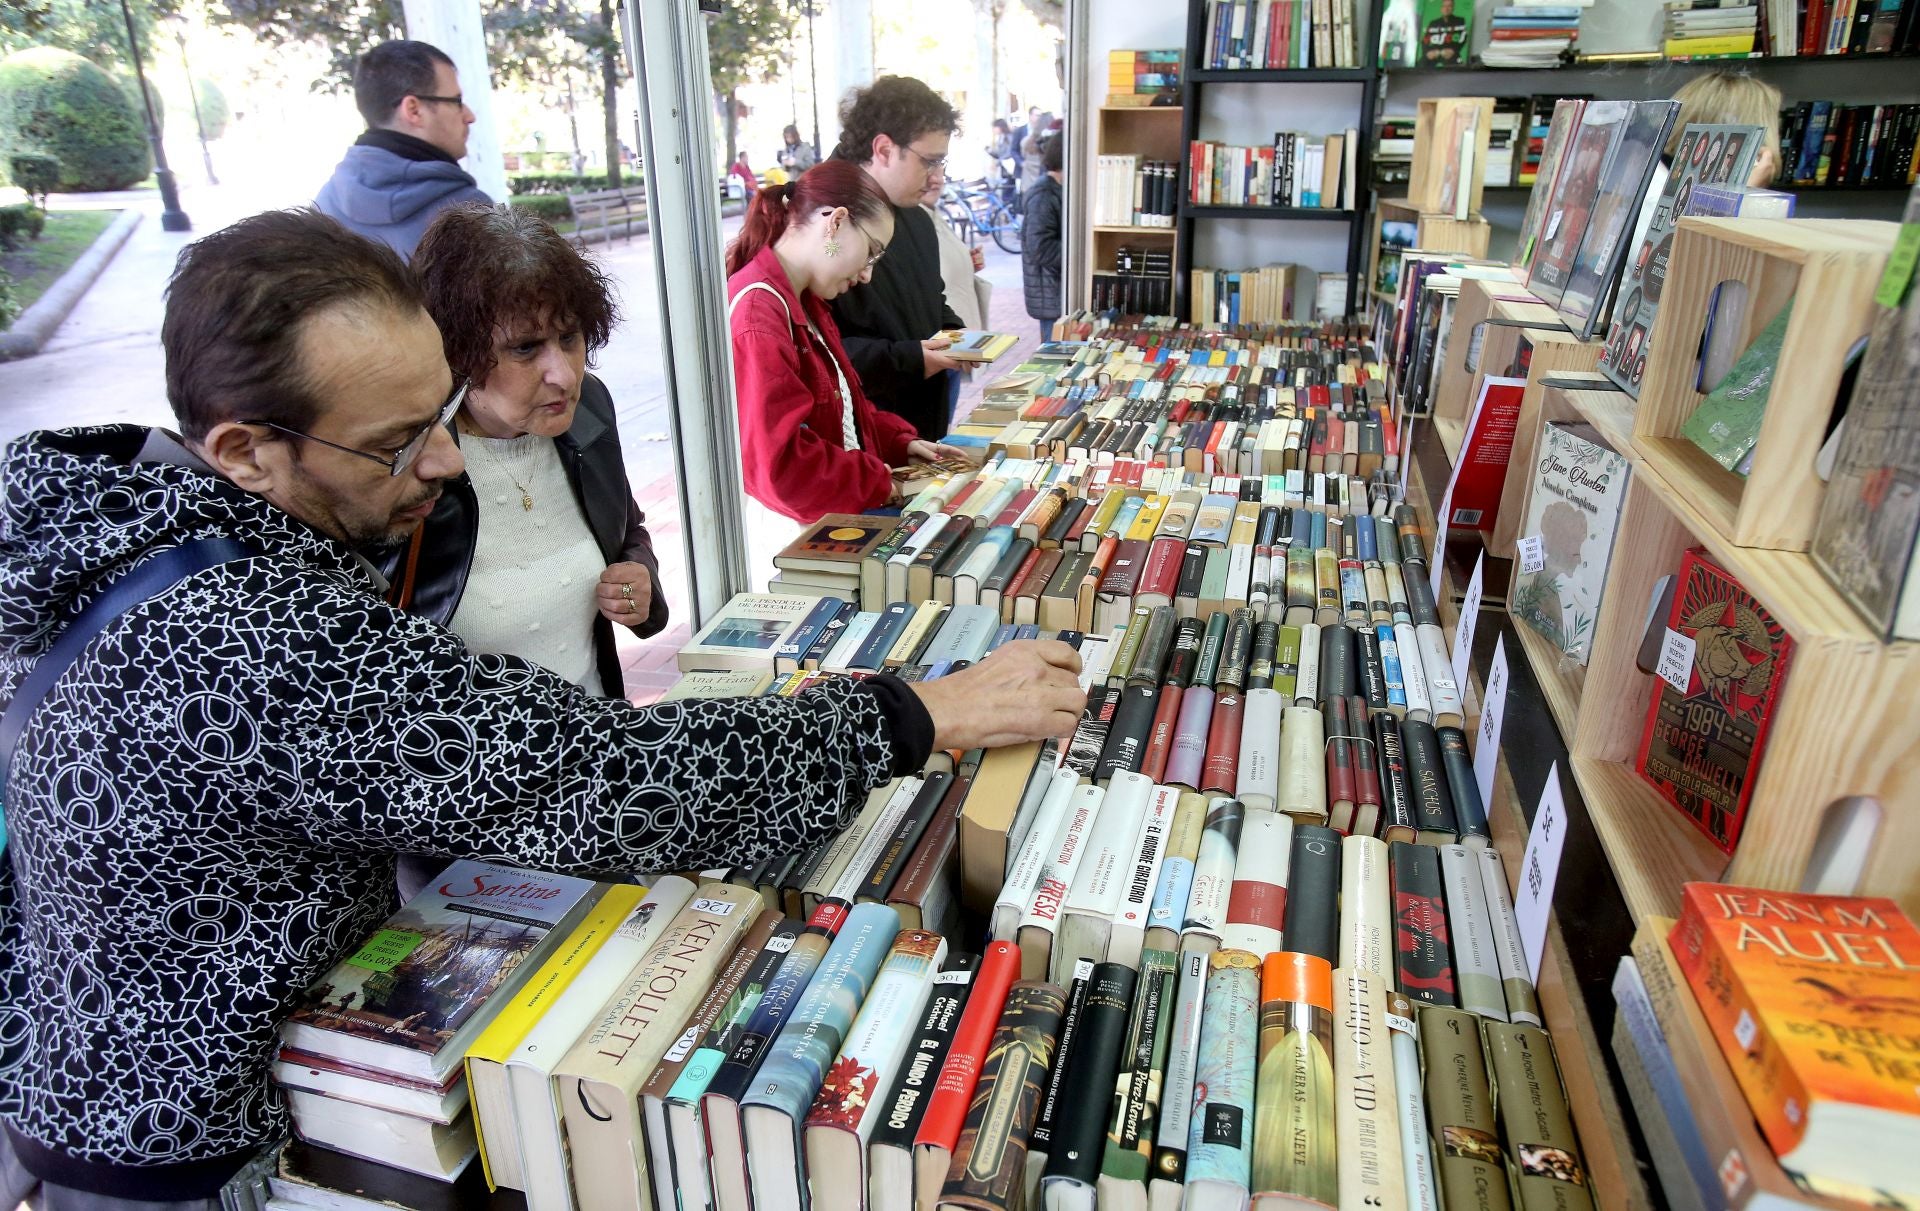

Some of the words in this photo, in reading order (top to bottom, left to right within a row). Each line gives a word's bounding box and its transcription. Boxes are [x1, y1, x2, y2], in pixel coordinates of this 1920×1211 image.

[1540, 454, 1567, 475] Jane
[1568, 465, 1607, 495] Austen
[1541, 477, 1565, 498] Novelas
[1565, 489, 1599, 514] Completas
[1668, 646, 1685, 662] NUEVO
[1670, 636, 1687, 652] LIBRO
[686, 674, 714, 683] Ana
[716, 675, 760, 684] Frank
[1658, 663, 1688, 689] 15,00€
[1666, 656, 1685, 672] PRECIO
[1655, 717, 1706, 756] GEORGE
[1684, 702, 1725, 742] 1984
[1650, 757, 1681, 783] REBELIÓN
[1681, 772, 1690, 787] EN
[1690, 777, 1700, 792] LA
[1701, 782, 1730, 808] GRANJA
[1683, 750, 1738, 796] ORWELL
[1073, 807, 1090, 831] MICHAEL
[1148, 826, 1161, 836] EL
[1057, 828, 1081, 866] CRICHTON
[1137, 833, 1160, 866] HOMBRE
[1305, 841, 1327, 856] Q
[438, 874, 561, 900] Sartine
[1127, 862, 1149, 904] GIRATORIO
[697, 899, 733, 915] 12€
[1031, 878, 1067, 921] PRESA
[1714, 892, 1826, 924] JEAN
[1832, 904, 1890, 930] M
[390, 933, 412, 942] LIBRO
[669, 927, 682, 939] LA
[671, 919, 722, 964] KEN
[861, 923, 873, 934] EL
[1371, 926, 1379, 944] NOAH
[1422, 909, 1434, 962] HISTORIADORA
[356, 951, 397, 967] 10,00€
[372, 946, 399, 956] PRECIO
[382, 940, 404, 949] NUEVO
[648, 938, 675, 967] CAÍDA
[770, 940, 792, 950] 10€
[1736, 921, 1920, 971] AUEL
[643, 968, 655, 980] DE
[722, 947, 748, 978] ALEJANDRO
[730, 955, 752, 985] TESORO
[833, 933, 867, 991] COMPOSITOR
[625, 979, 642, 997] LOS
[936, 974, 960, 983] 10€
[1348, 977, 1369, 998] EL
[693, 977, 725, 1021] JODOROWSKY
[759, 982, 782, 1007] ALTA
[768, 979, 798, 1018] CERCAS
[588, 998, 628, 1045] GIGANTES
[597, 964, 688, 1067] FOLLETT
[698, 1003, 723, 1034] SOMBRA
[924, 996, 946, 1031] Crichton
[937, 997, 959, 1032] Michael
[1228, 1003, 1238, 1034] PERDIDO
[1344, 1002, 1372, 1045] HIJO
[1390, 1016, 1416, 1033] 10€
[791, 1000, 831, 1061] TORMENTAS
[919, 1038, 940, 1050] EL
[1062, 1026, 1074, 1047] HABLO
[905, 1051, 935, 1086] MUNDO
[1056, 1045, 1069, 1069] CUANDO
[1051, 1068, 1063, 1089] HABLO
[1294, 1046, 1306, 1103] PALMERAS
[888, 1087, 921, 1129] PERDIDO
[1125, 1069, 1149, 1141] Pérez-Reverte
[1353, 1074, 1377, 1111] VID
[1042, 1097, 1055, 1122] CORRER
[1409, 1102, 1422, 1145] Alquimista
[1293, 1127, 1306, 1167] NIEVE
[1358, 1117, 1377, 1149] CARLOS
[1360, 1150, 1381, 1187] CLAVIJO
[1415, 1152, 1427, 1182] Paulo
[1473, 1165, 1486, 1177] EL
[1417, 1183, 1430, 1211] Coelh
